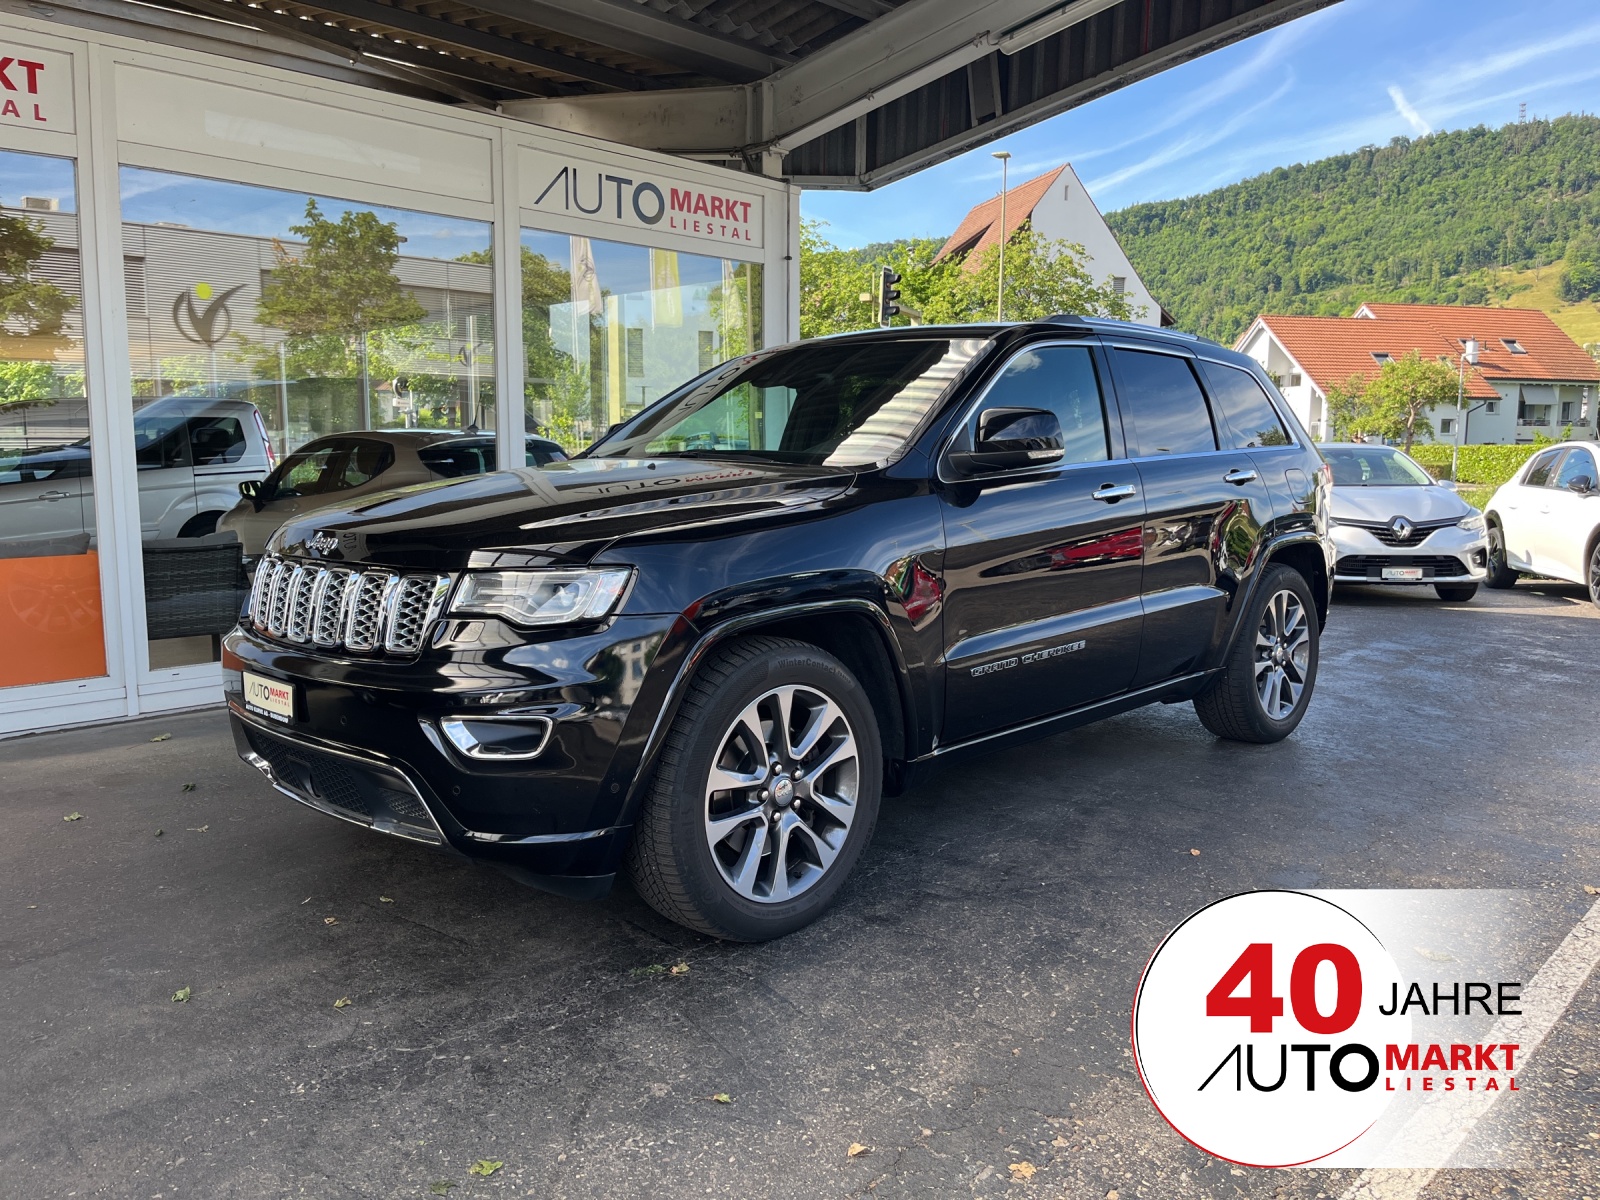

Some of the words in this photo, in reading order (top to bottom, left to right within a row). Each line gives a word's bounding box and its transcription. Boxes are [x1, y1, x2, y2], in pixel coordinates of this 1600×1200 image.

[533, 166, 665, 225] AUTO
[670, 187, 752, 224] MARKT
[670, 216, 752, 241] LIESTAL
[305, 531, 339, 556] Jeep
[777, 658, 837, 675] WinterContact
[970, 657, 1019, 678] GRAND
[1021, 640, 1086, 664] CHEROKEE
[249, 681, 270, 701] AUTO
[270, 687, 289, 701] MARKT
